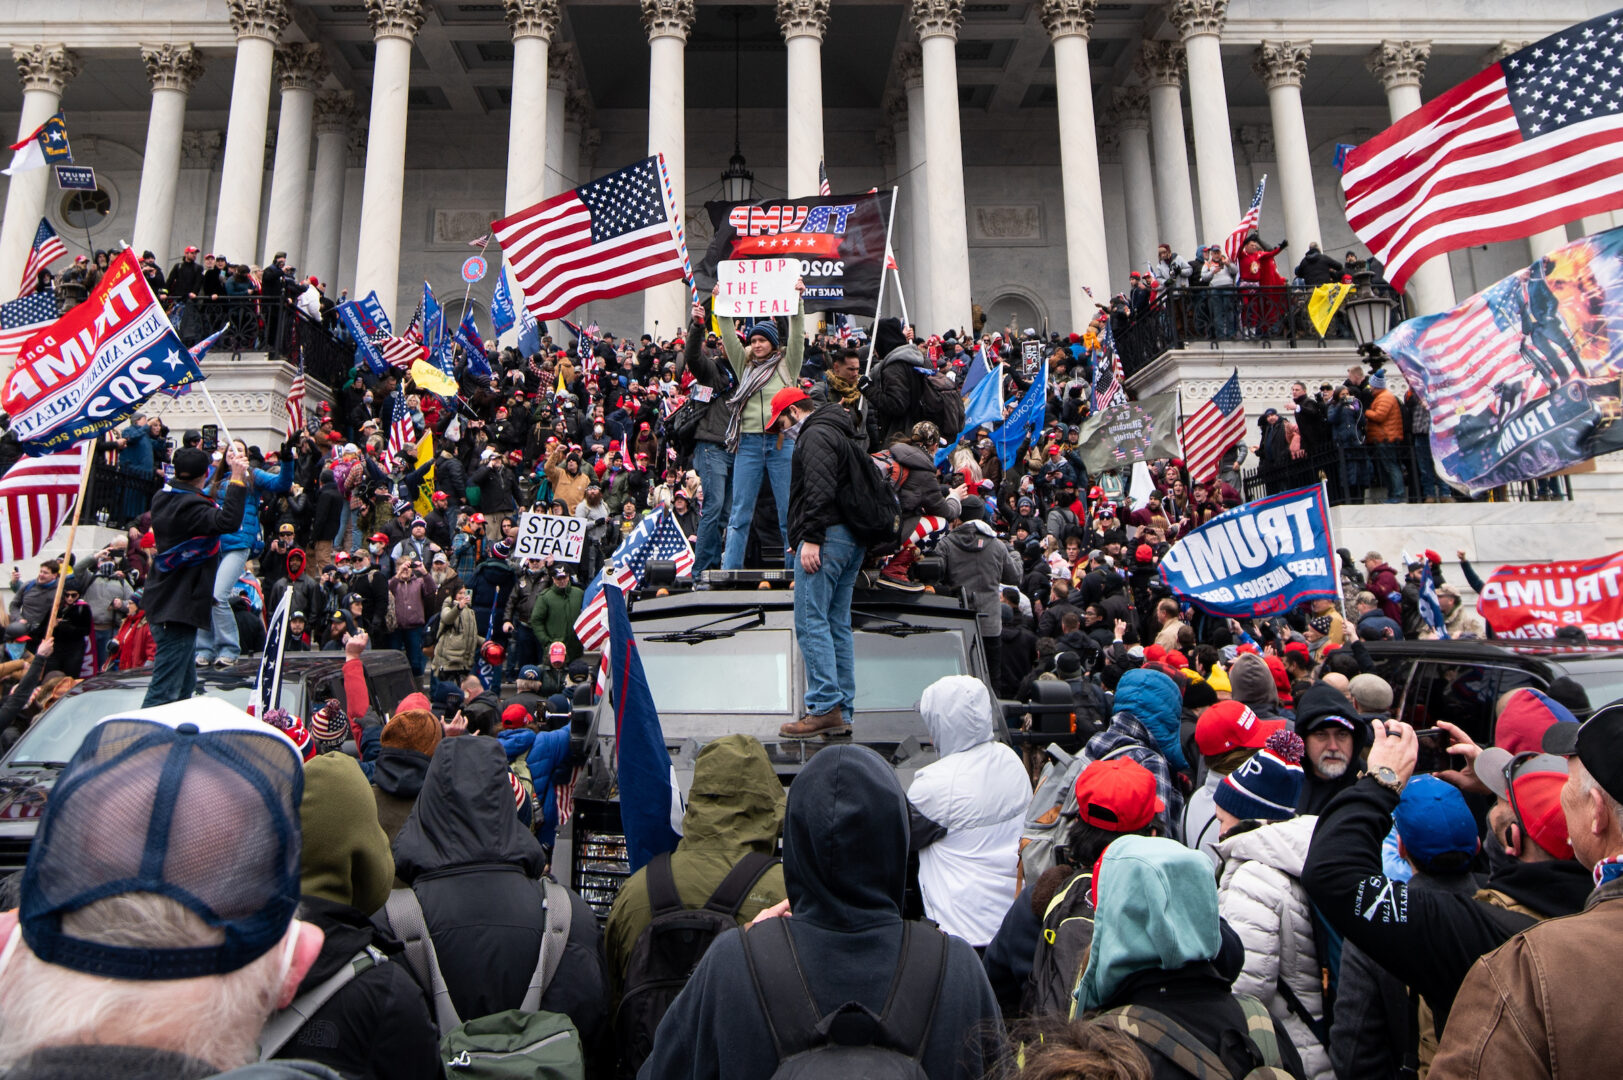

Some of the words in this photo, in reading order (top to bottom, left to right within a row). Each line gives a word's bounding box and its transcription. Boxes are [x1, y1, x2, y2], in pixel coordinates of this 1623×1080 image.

[59, 171, 92, 179] TRUMP
[738, 260, 786, 274] STOP
[726, 282, 758, 295] THE
[734, 299, 790, 313] STEAL
[350, 316, 366, 338] MORE
[361, 336, 384, 368] BULLSHIT
[1025, 345, 1033, 374] BIDN
[526, 516, 581, 540] STOP
[1382, 898, 1390, 922] 1776
